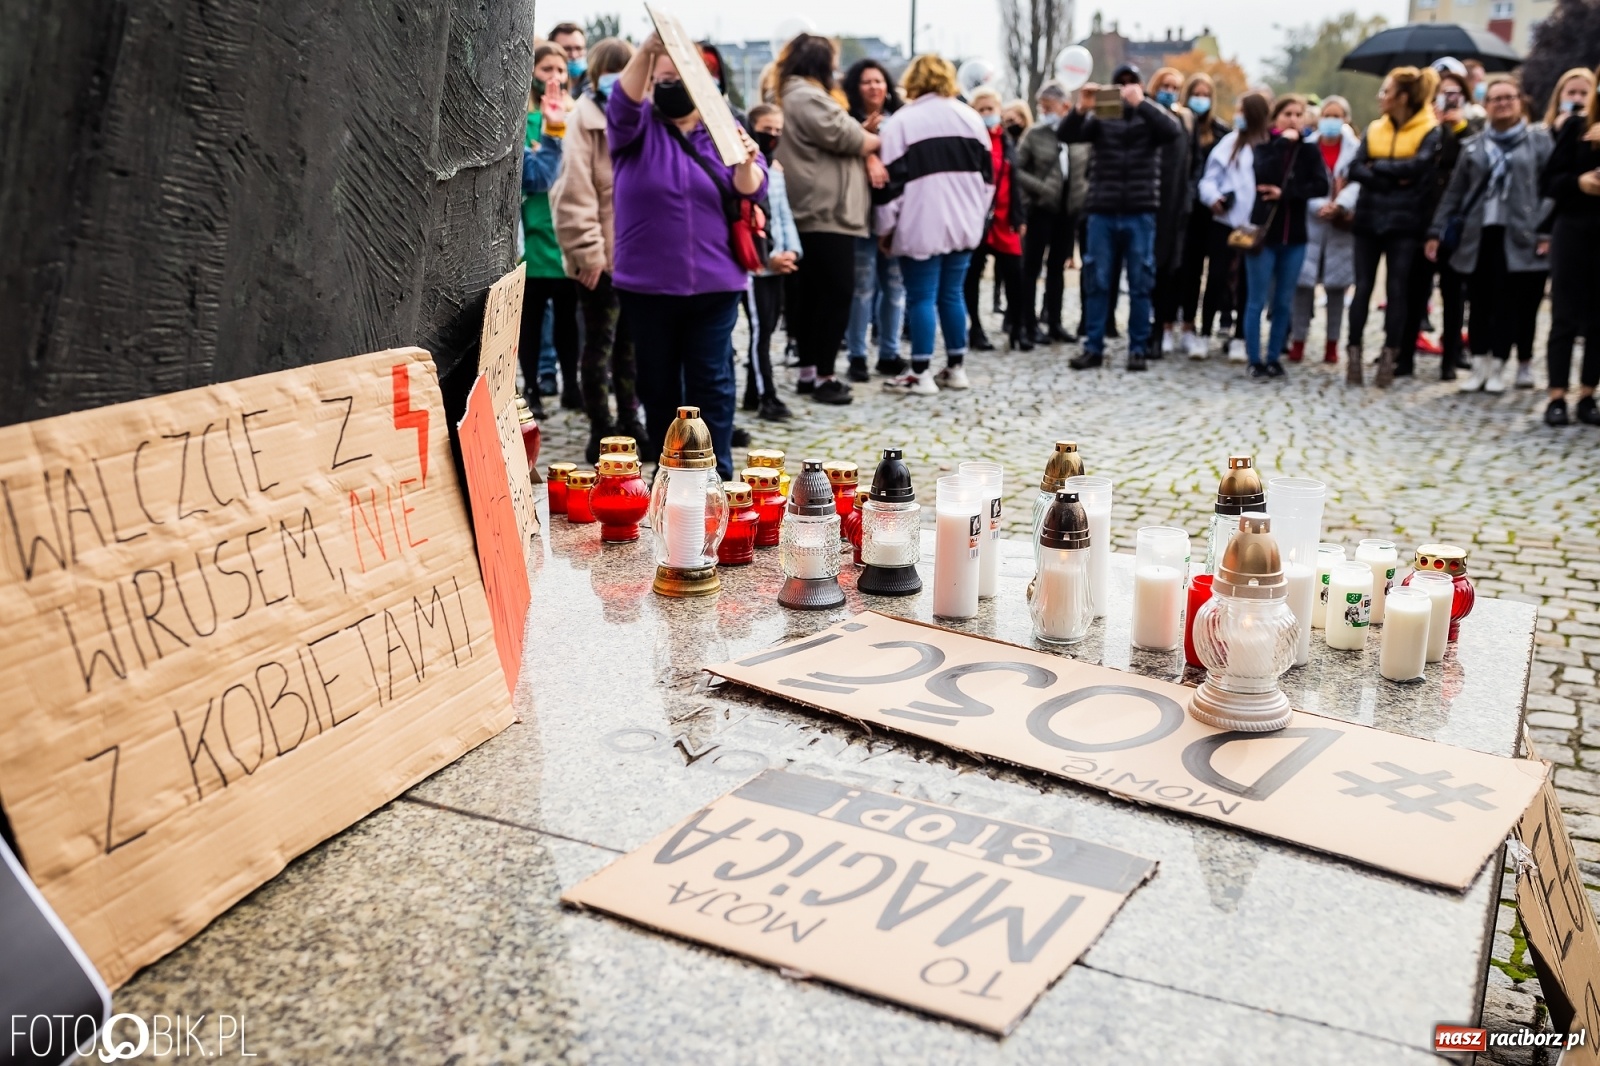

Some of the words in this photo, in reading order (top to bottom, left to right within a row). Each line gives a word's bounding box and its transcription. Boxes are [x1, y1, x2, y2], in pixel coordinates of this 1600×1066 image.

[2, 409, 280, 581] WALCZCIE
[321, 396, 373, 470] Z
[57, 506, 348, 693] WIRUSEM,
[349, 478, 429, 574] NIE
[85, 745, 147, 855] Z
[173, 576, 473, 800] KOBIETAMI
[817, 790, 1054, 868] STOP!
[667, 881, 827, 943] MOJA
[919, 957, 1004, 999] TO
